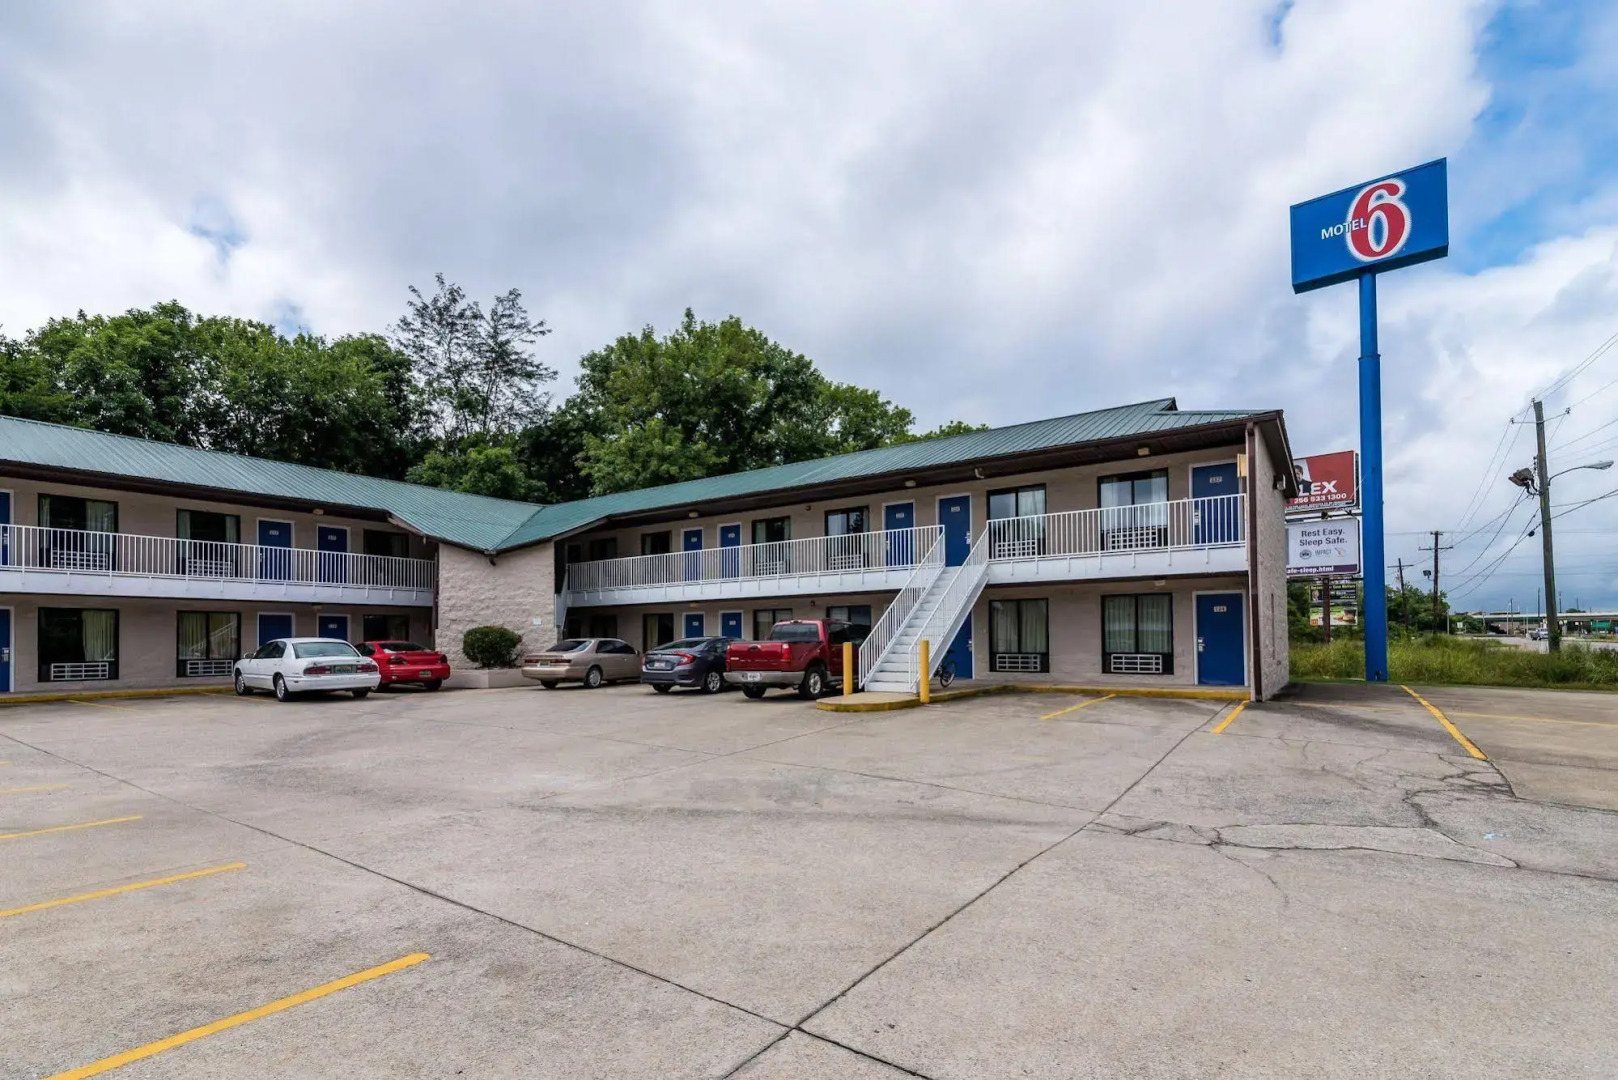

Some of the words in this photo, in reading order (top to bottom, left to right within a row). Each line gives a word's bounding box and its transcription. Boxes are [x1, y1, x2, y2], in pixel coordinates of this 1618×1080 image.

[1321, 217, 1368, 240] MOTEL
[1347, 180, 1410, 261] 6
[1294, 496, 1309, 504] 256
[1301, 529, 1320, 537] Rest
[1322, 528, 1345, 536] Easy.
[1299, 538, 1323, 546] Sleep
[1325, 536, 1347, 544] Safe.
